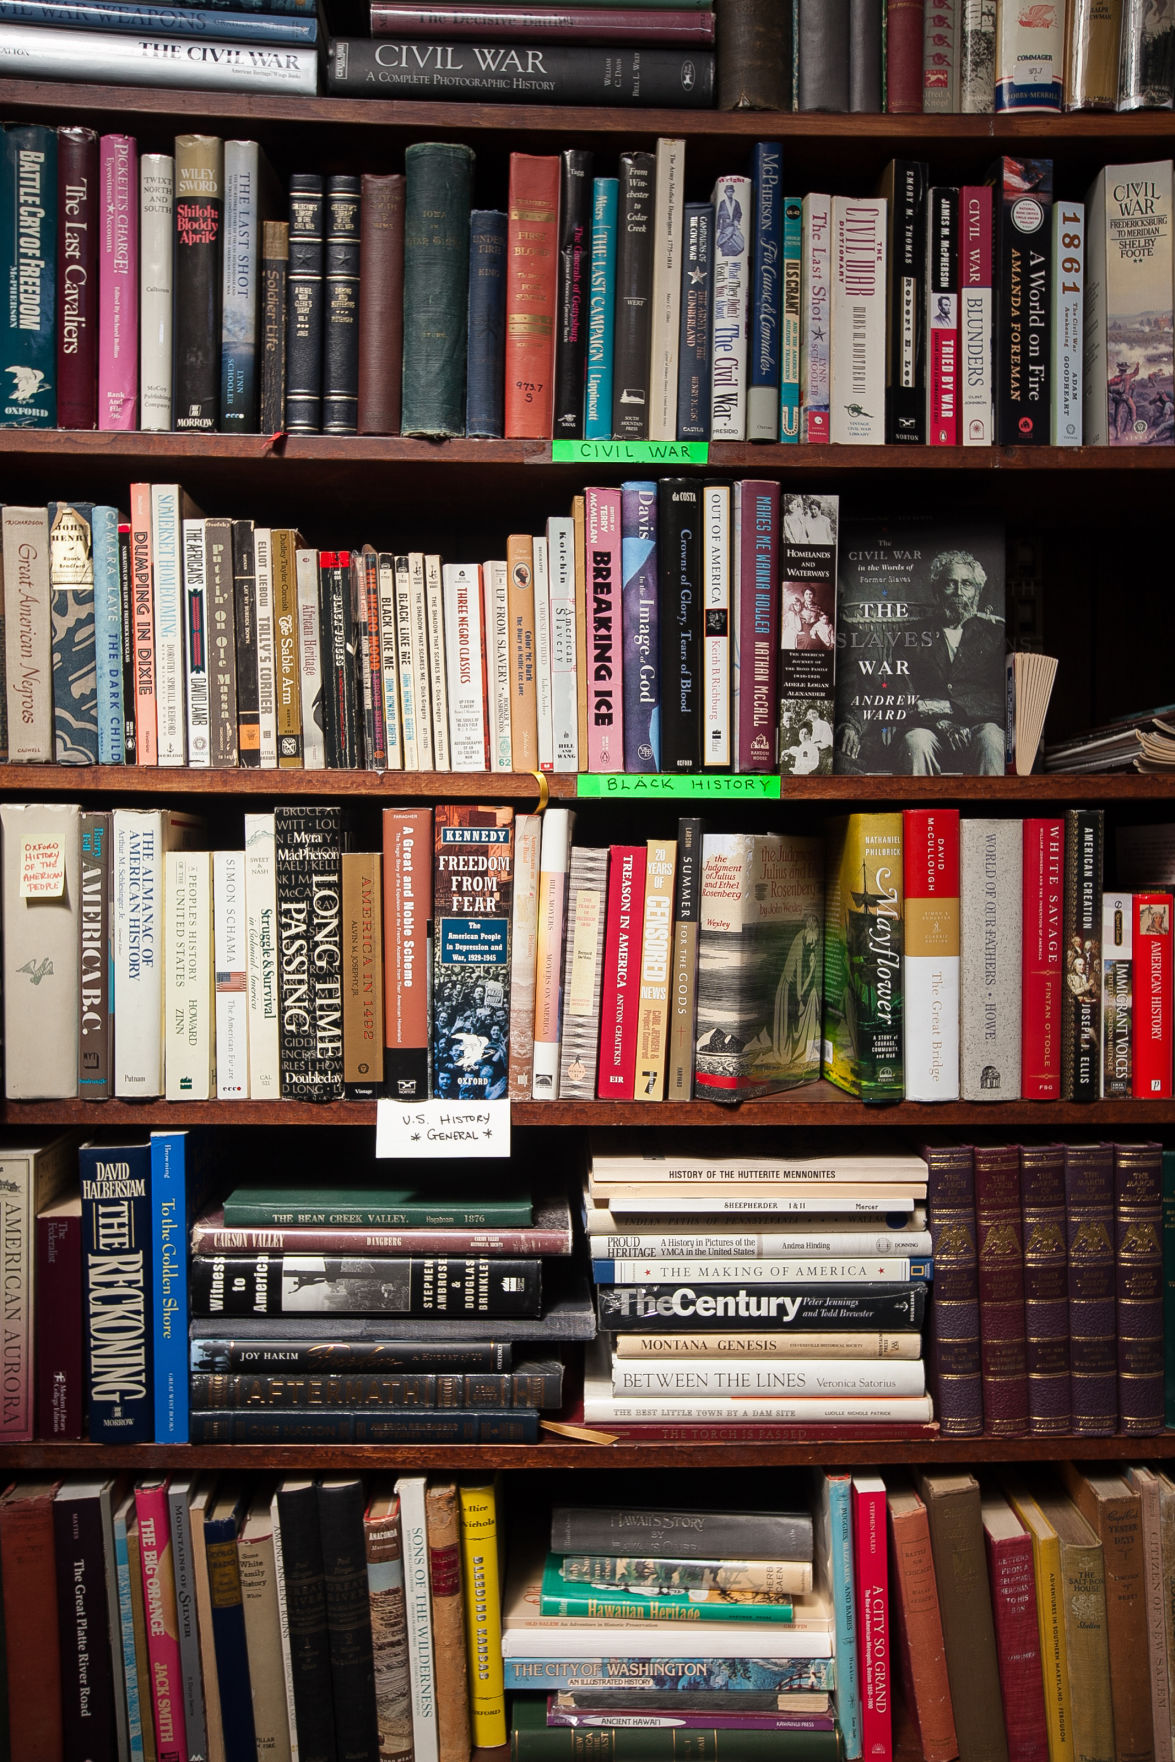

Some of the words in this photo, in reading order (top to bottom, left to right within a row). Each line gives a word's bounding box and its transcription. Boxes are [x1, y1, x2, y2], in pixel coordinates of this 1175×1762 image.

[138, 42, 181, 59] THE
[188, 46, 244, 65] CIVIL
[249, 52, 300, 69] WAR
[375, 45, 463, 69] CIVIL
[473, 48, 547, 74] WAR
[366, 72, 375, 82] A
[378, 72, 429, 85] COMPLETE
[433, 74, 511, 88] PHOTOGRAPHIC
[513, 78, 555, 91] HISTORY
[20, 151, 44, 204] BATTLE
[181, 168, 215, 180] WILEY
[629, 168, 647, 176] From
[65, 178, 87, 215] The
[179, 180, 218, 192] SWORD
[1113, 182, 1161, 200] CIVIL
[177, 204, 218, 218] Shiloh:
[627, 212, 647, 221] Cedar
[1119, 198, 1155, 216] WAR
[20, 206, 44, 239] CRY
[177, 218, 218, 231] Bloody
[627, 224, 647, 232] Creek
[969, 200, 981, 240] CIVIL
[1110, 216, 1167, 229] FREDERICKSBURG
[65, 222, 87, 259] Last
[179, 232, 216, 245] April
[1129, 227, 1160, 236] MERIDIAN
[20, 238, 42, 256] OF
[1062, 212, 1080, 295] 1861
[1119, 238, 1156, 249] SHELBY
[1120, 247, 1154, 259] FOOTE
[969, 249, 981, 283] WAR
[1030, 251, 1043, 266] A
[19, 258, 41, 330] FREEDOM
[1028, 270, 1045, 327] World
[65, 265, 87, 354] Cavaliers
[967, 297, 984, 386] BLUNDERS
[1028, 334, 1039, 356] on
[516, 381, 543, 392] 973.7
[1028, 364, 1045, 400] Fire
[5, 407, 48, 417] OXFORD
[177, 418, 214, 427] MORROW
[580, 444, 634, 458] CIVIL
[649, 445, 690, 458] WAR
[756, 496, 771, 531] MAKES
[679, 529, 692, 571] Crowns
[756, 535, 771, 550] ME
[787, 549, 830, 558] HOMELANDS
[18, 544, 37, 587] Great
[134, 532, 149, 615] DUMPING
[756, 554, 771, 589] WANNA
[787, 569, 829, 578] WATERWAYS
[681, 575, 689, 585] of
[457, 587, 467, 614] THREE
[678, 589, 692, 626] Glory,
[860, 603, 909, 618] THE
[381, 597, 392, 627] BLACK
[592, 551, 613, 682] BREAKING
[755, 594, 770, 634] HOLLER
[19, 589, 40, 659] American
[137, 622, 150, 640] IN
[457, 616, 468, 646] NEGRO
[382, 632, 393, 653] LIKE
[680, 630, 691, 660] Tears
[137, 648, 152, 695] DIXIE
[384, 655, 394, 670] ME
[459, 648, 470, 684] CLASSICS
[680, 664, 690, 674] of
[858, 661, 910, 675] WAR
[14, 663, 40, 724] Negroes
[680, 678, 691, 712] Blood
[594, 690, 612, 726] ICE
[607, 777, 674, 790] BLACK
[691, 779, 771, 791] HISTORY
[142, 830, 154, 861] THE
[446, 830, 506, 841] KENNEDY
[25, 842, 59, 852] OXFORD
[25, 852, 59, 862] HISTORY
[25, 863, 36, 871] OF
[40, 862, 57, 870] THE
[129, 830, 141, 913] AMERICAN
[439, 856, 510, 872] FREEDOM
[23, 871, 62, 882] AMERICAN
[27, 882, 59, 891] PEOPLE
[451, 877, 498, 891] FROM
[622, 855, 633, 911] TREASON
[142, 866, 154, 943] ALMANAC
[452, 897, 496, 912] FEAR
[620, 916, 630, 929] IN
[129, 918, 140, 981] HISTORY
[142, 949, 154, 967] OF
[617, 932, 629, 988] AMERICA
[1151, 941, 1161, 994] AMERICAN
[932, 972, 943, 996] The
[931, 1001, 944, 1035] Great
[1151, 996, 1162, 1040] HISTORY
[928, 1041, 944, 1082] Bridge
[458, 1077, 488, 1086] OXFORD
[402, 1114, 429, 1126] U.S.
[440, 1113, 490, 1125] HISTORY
[427, 1129, 479, 1141] GENERAL
[96, 1162, 130, 1181] DAVID
[669, 1170, 703, 1179] HISTORY
[706, 1170, 716, 1179] OF
[719, 1170, 735, 1179] THE
[738, 1170, 780, 1179] HUTTERITE
[783, 1169, 836, 1179] MENNONITES
[83, 1180, 145, 1199] HALBERSTAM
[161, 1199, 176, 1216] To
[98, 1200, 130, 1250] THE
[272, 1214, 295, 1223] THE
[298, 1214, 327, 1223] BEAN
[330, 1214, 363, 1223] CREEK
[464, 1214, 485, 1223] 1876
[161, 1219, 178, 1241] the
[782, 1241, 804, 1249] Andrea
[806, 1242, 831, 1251] Hinding
[161, 1244, 179, 1294] Golden
[88, 1250, 146, 1403] RECKONING
[163, 1298, 179, 1339] Shore
[641, 1340, 708, 1350] MONTANA
[717, 1340, 777, 1350] GENESIS
[240, 1352, 261, 1361] JOY
[264, 1351, 299, 1360] HAKIM
[623, 1373, 708, 1388] BETWEEN
[714, 1373, 751, 1387] THE
[756, 1373, 806, 1387] LINES
[816, 1378, 855, 1387] Veronica
[858, 1378, 896, 1387] Satorius
[103, 1419, 135, 1427] MORROW
[74, 1559, 85, 1581] The
[472, 1556, 486, 1622] BLEEDING
[872, 1586, 882, 1595] A
[74, 1584, 85, 1616] Great
[872, 1599, 885, 1634] CITY
[76, 1619, 88, 1651] Platte
[477, 1628, 489, 1680] KANSAS
[873, 1638, 886, 1657] SO
[77, 1654, 89, 1684] River
[512, 1664, 542, 1676] THE
[545, 1664, 577, 1675] CITY
[579, 1664, 601, 1675] OF
[607, 1663, 707, 1676] WASHINGTON
[875, 1662, 887, 1713] GRAND
[80, 1687, 91, 1717] Road
